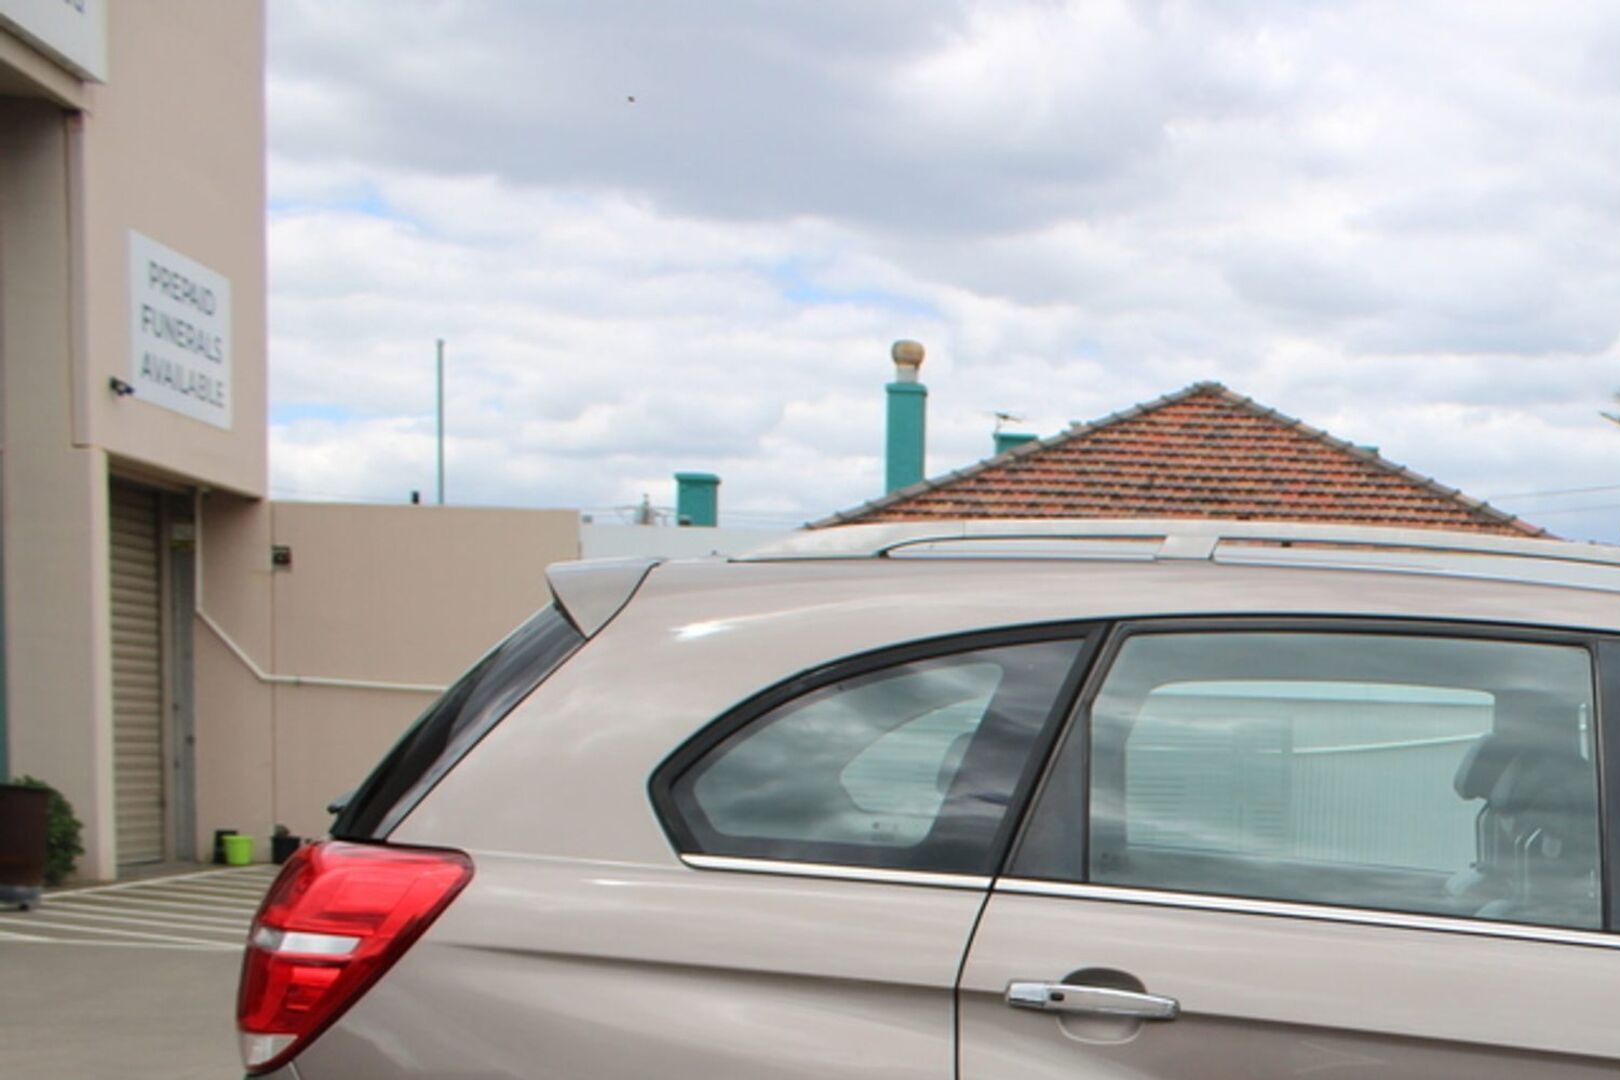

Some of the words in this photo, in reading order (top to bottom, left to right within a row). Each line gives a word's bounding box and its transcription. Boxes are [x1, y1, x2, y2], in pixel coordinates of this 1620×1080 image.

[149, 260, 215, 317] PREPAID
[141, 302, 222, 364] FUNERALS
[141, 352, 225, 408] AVAILABLE
